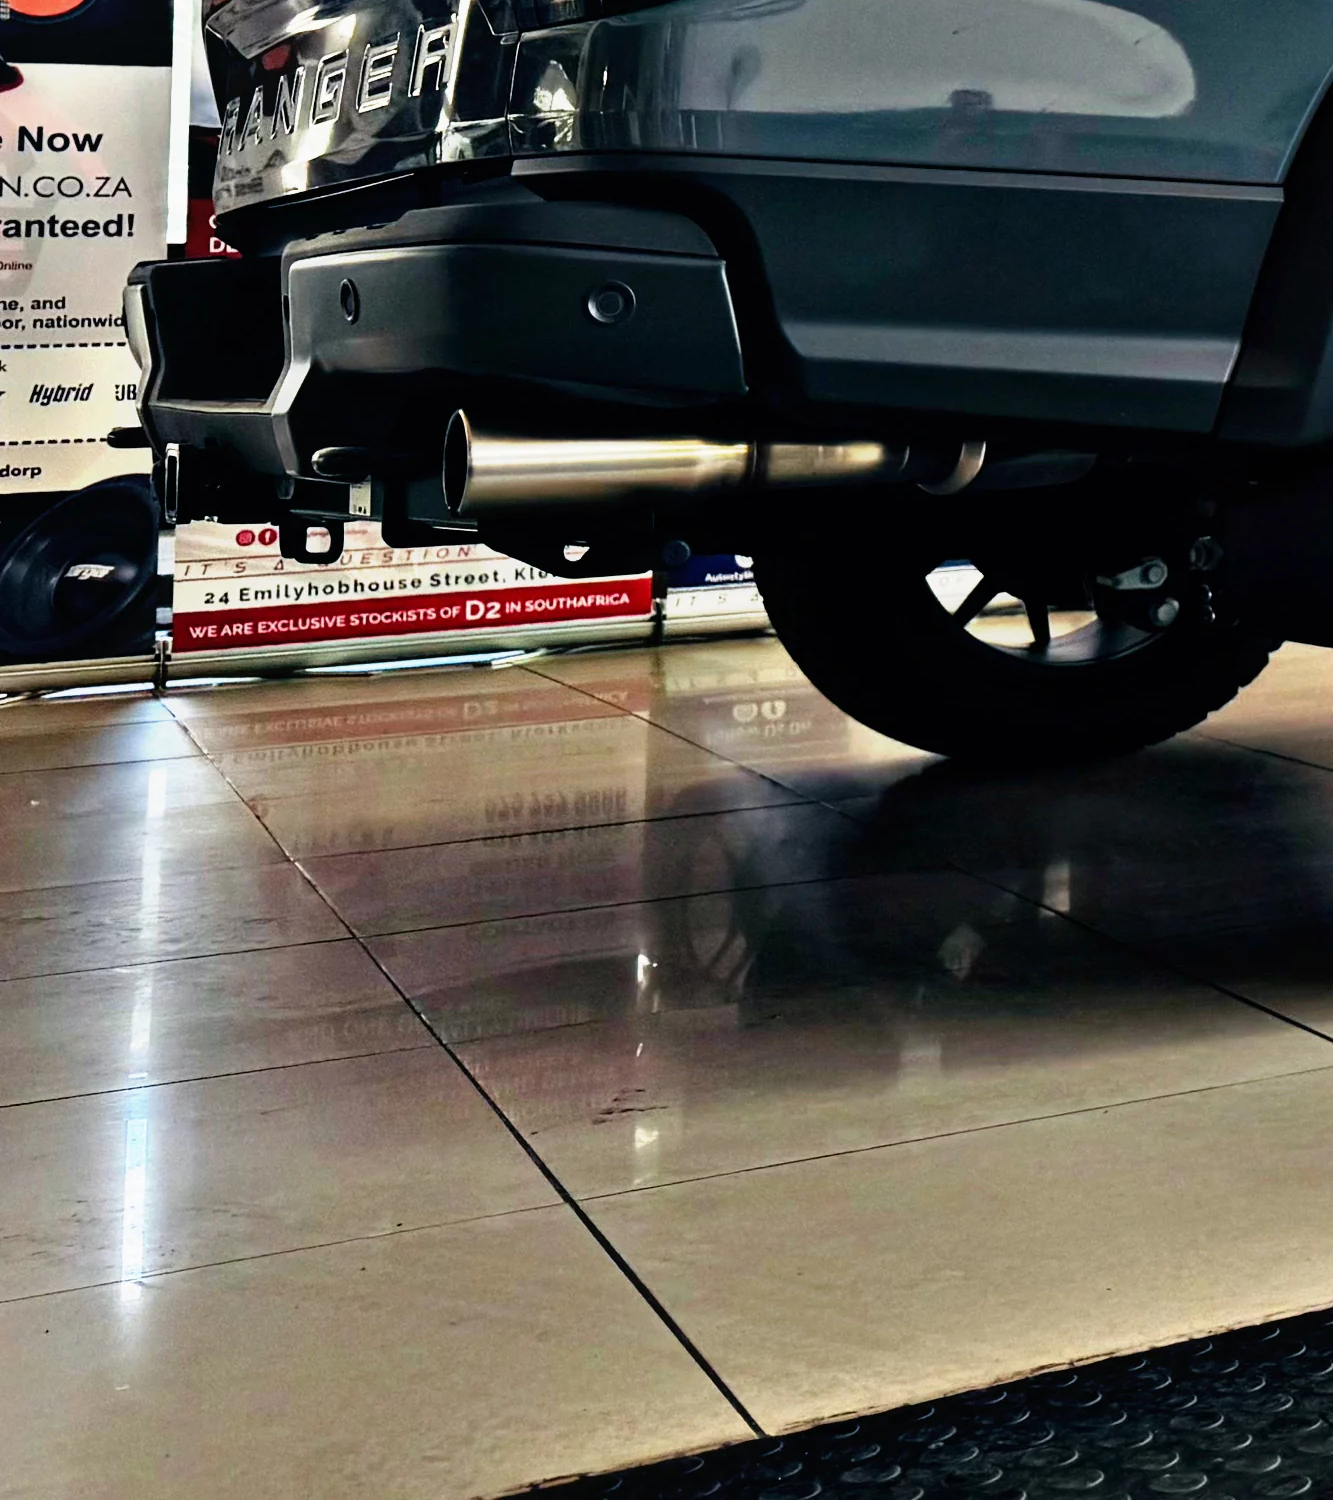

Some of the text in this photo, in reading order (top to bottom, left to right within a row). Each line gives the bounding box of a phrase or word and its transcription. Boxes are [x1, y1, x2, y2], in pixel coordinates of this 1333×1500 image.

[217, 12, 458, 157] RANGER
[17, 125, 103, 152] Now
[0, 176, 132, 198] N.CO.ZA
[0, 213, 135, 238] anteed!
[31, 296, 66, 310] and
[0, 318, 25, 332] or,
[29, 383, 94, 406] Hybrid
[318, 546, 471, 568] UESTION
[204, 591, 230, 605] 24
[239, 577, 422, 603] Emilyhobhouse
[189, 593, 630, 639] WE ARE EXCLUSIVE STOCKISTS OF D2 IN SOUTHAFRICA
